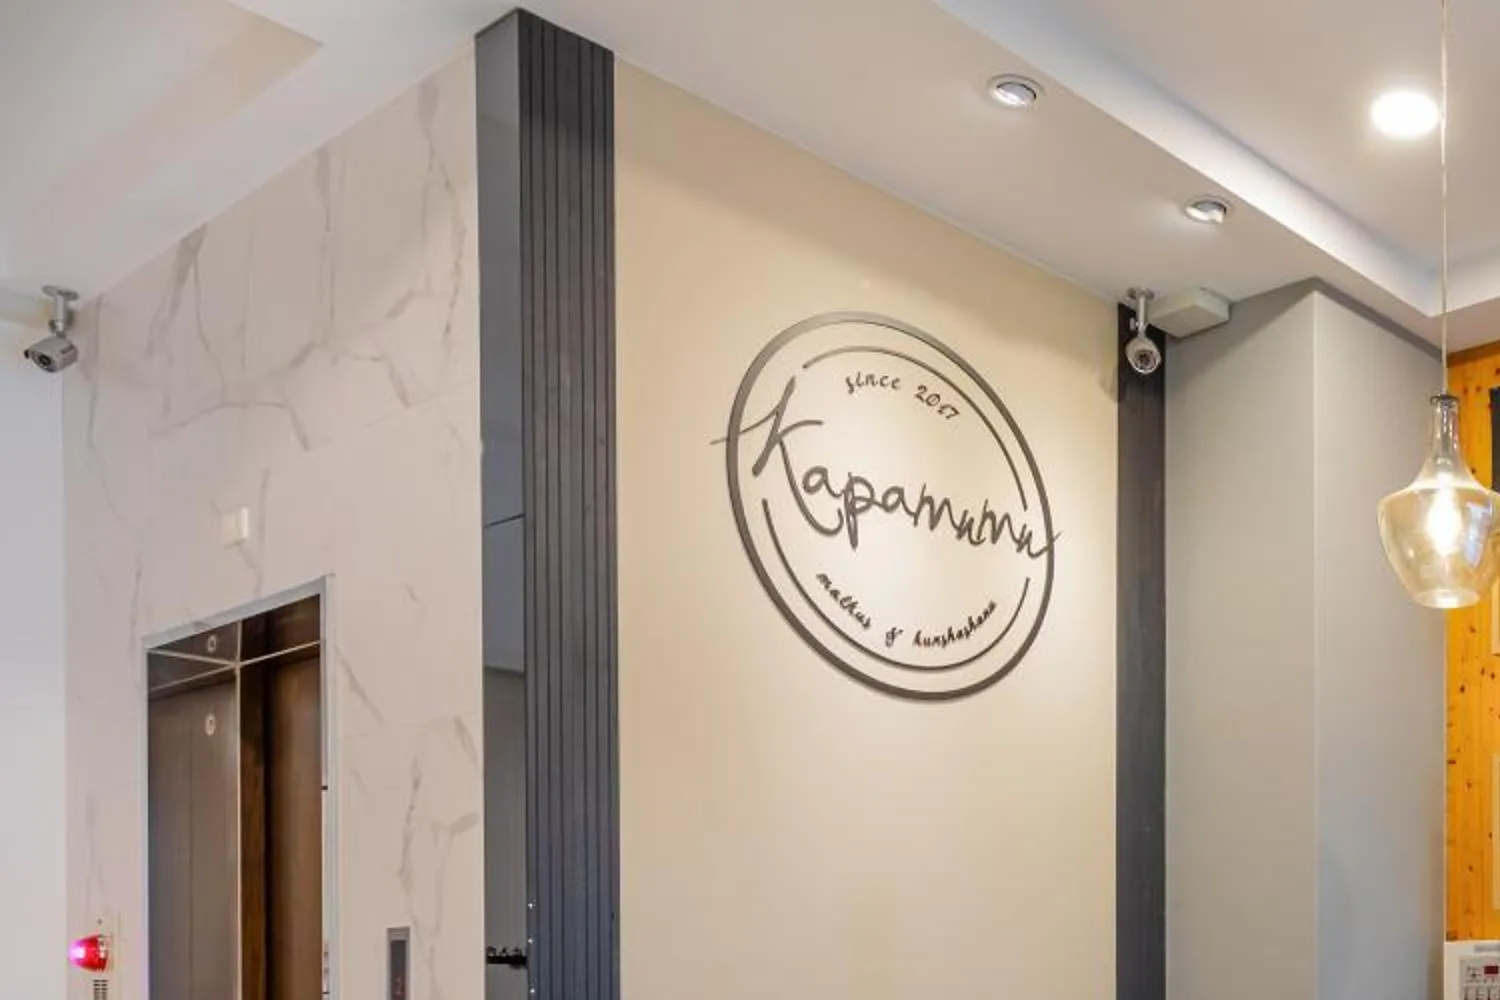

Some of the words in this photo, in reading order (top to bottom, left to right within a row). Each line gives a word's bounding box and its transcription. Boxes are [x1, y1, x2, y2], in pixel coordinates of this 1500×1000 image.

[845, 371, 901, 395] since
[914, 384, 960, 420] 2017
[709, 375, 1061, 558] Kapamumu
